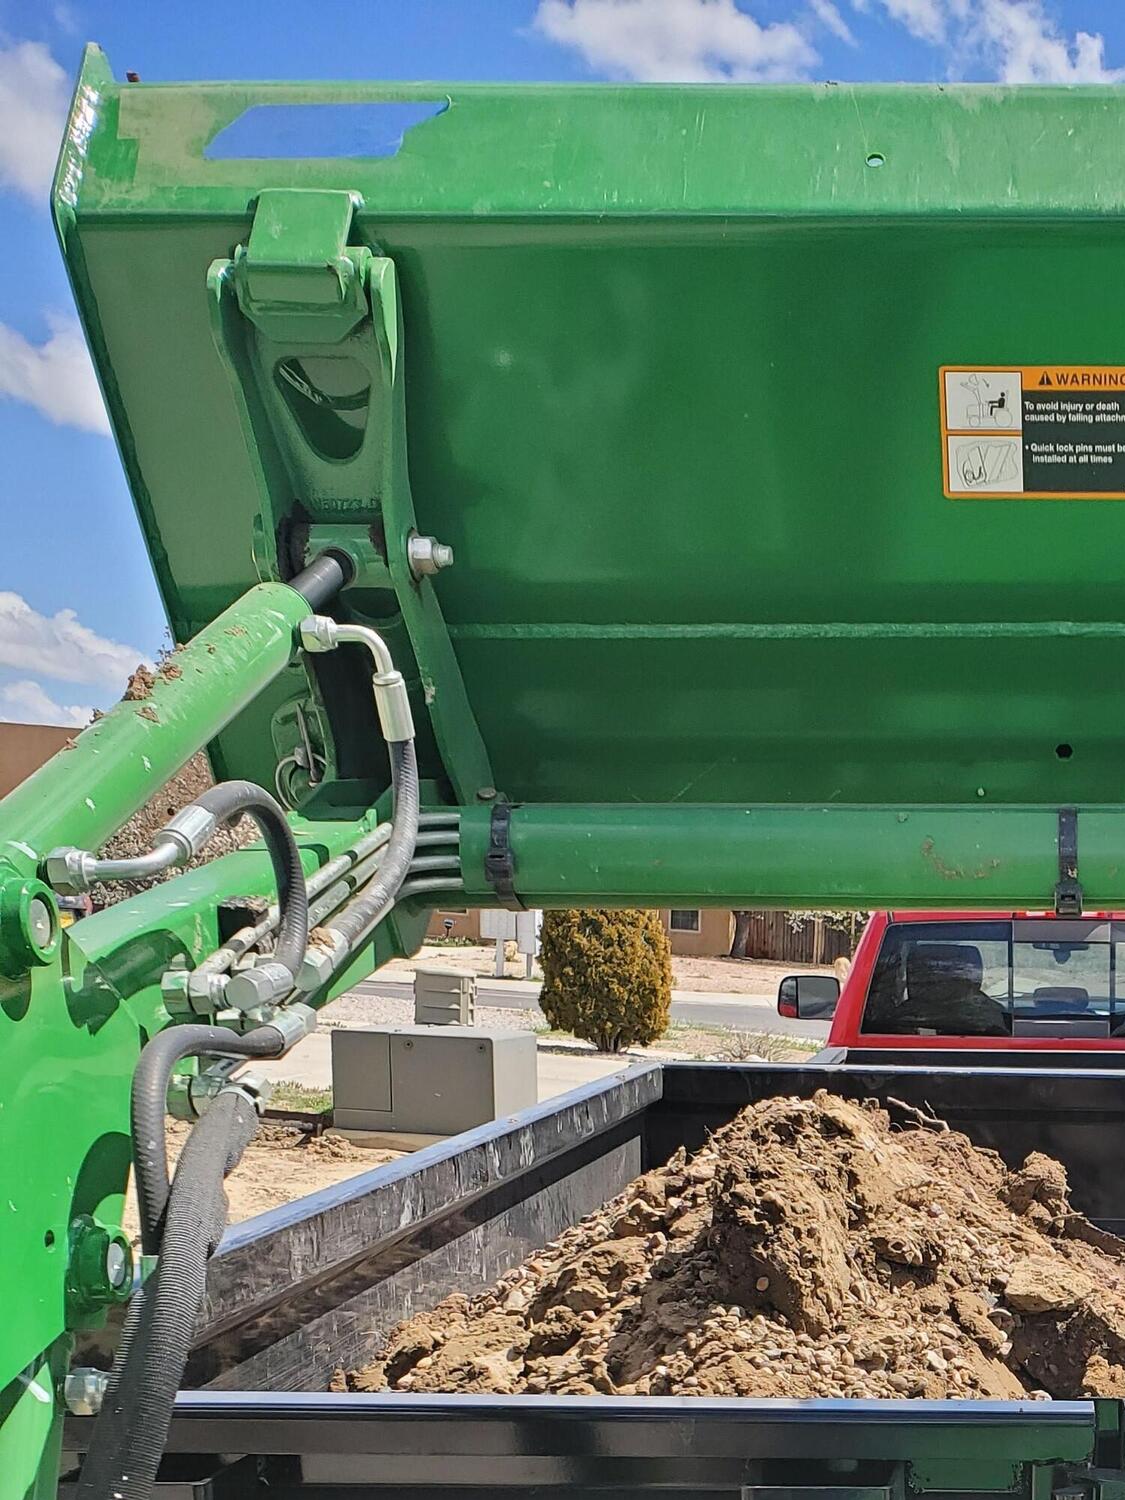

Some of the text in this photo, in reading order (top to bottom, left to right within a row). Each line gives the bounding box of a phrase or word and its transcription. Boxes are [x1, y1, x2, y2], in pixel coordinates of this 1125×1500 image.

[1024, 401, 1120, 412] To avoid injury or death
[1024, 413, 1055, 422] caused
[1056, 413, 1067, 424] by
[1068, 413, 1094, 424] falling
[1030, 443, 1055, 453] Quick
[1056, 443, 1074, 452] lock
[1075, 443, 1093, 454] pins
[1094, 444, 1116, 452] must
[1032, 454, 1113, 463] installed at all times
